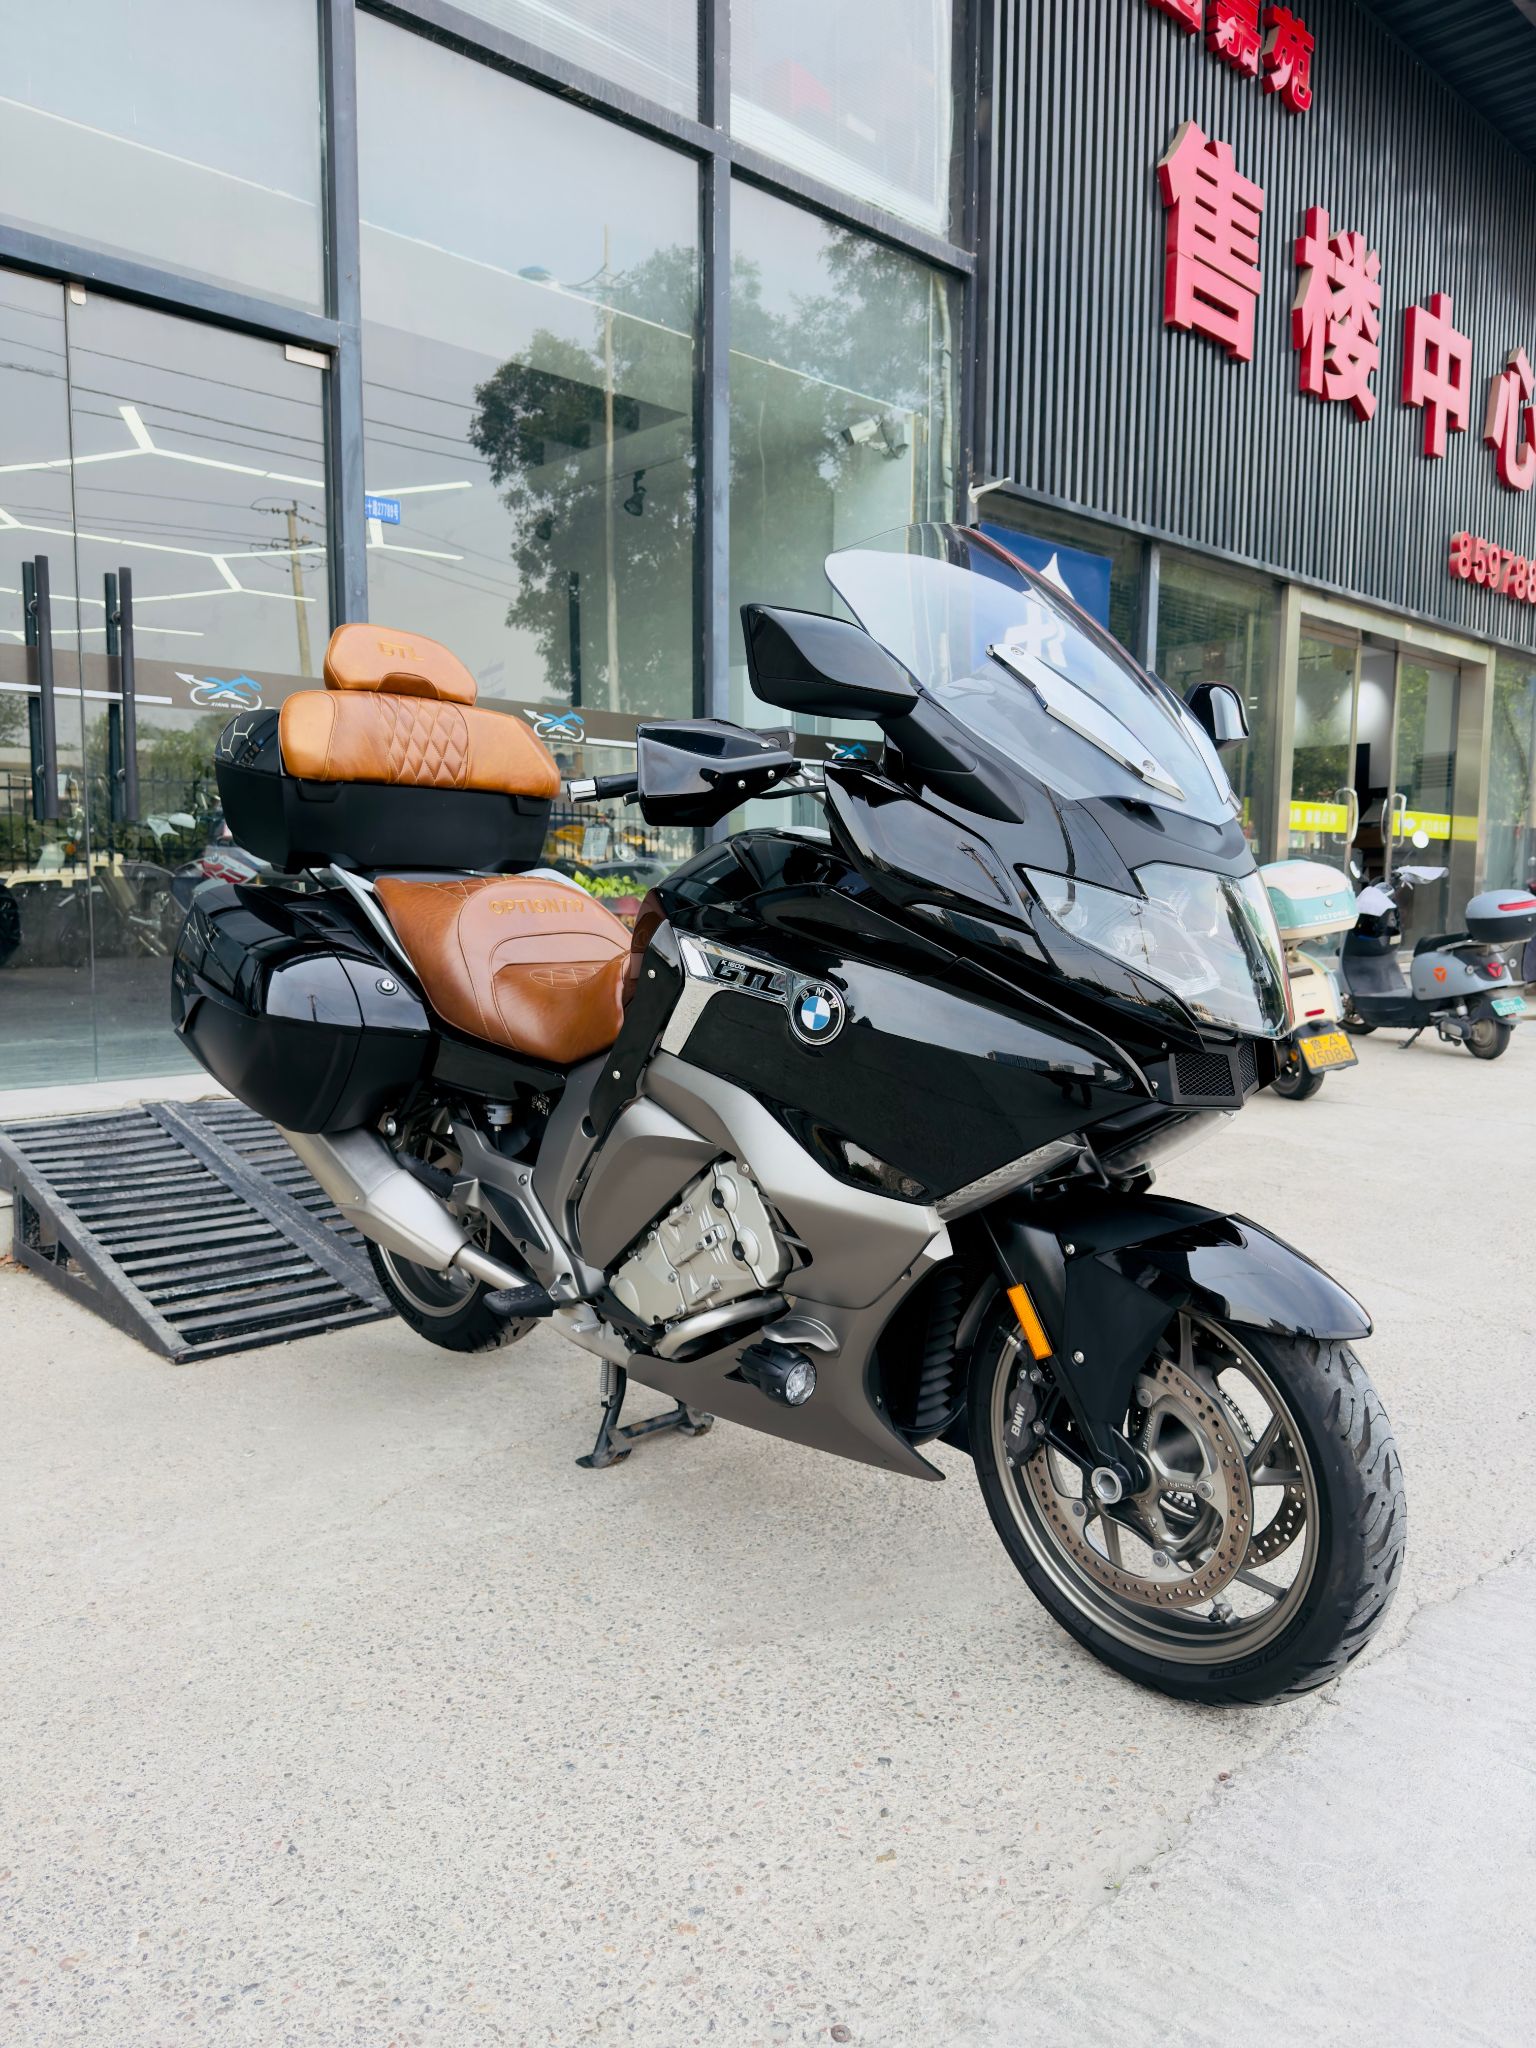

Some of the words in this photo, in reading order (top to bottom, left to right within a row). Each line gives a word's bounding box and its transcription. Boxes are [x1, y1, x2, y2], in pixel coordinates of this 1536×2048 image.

[1157, 119, 1536, 491] 售楼中心
[1449, 531, 1536, 604] 859788
[376, 640, 425, 662] GTL
[713, 960, 786, 996] GTL
[728, 961, 746, 970] 1600
[800, 986, 839, 1009] BMW
[1010, 1402, 1025, 1437] BMW
